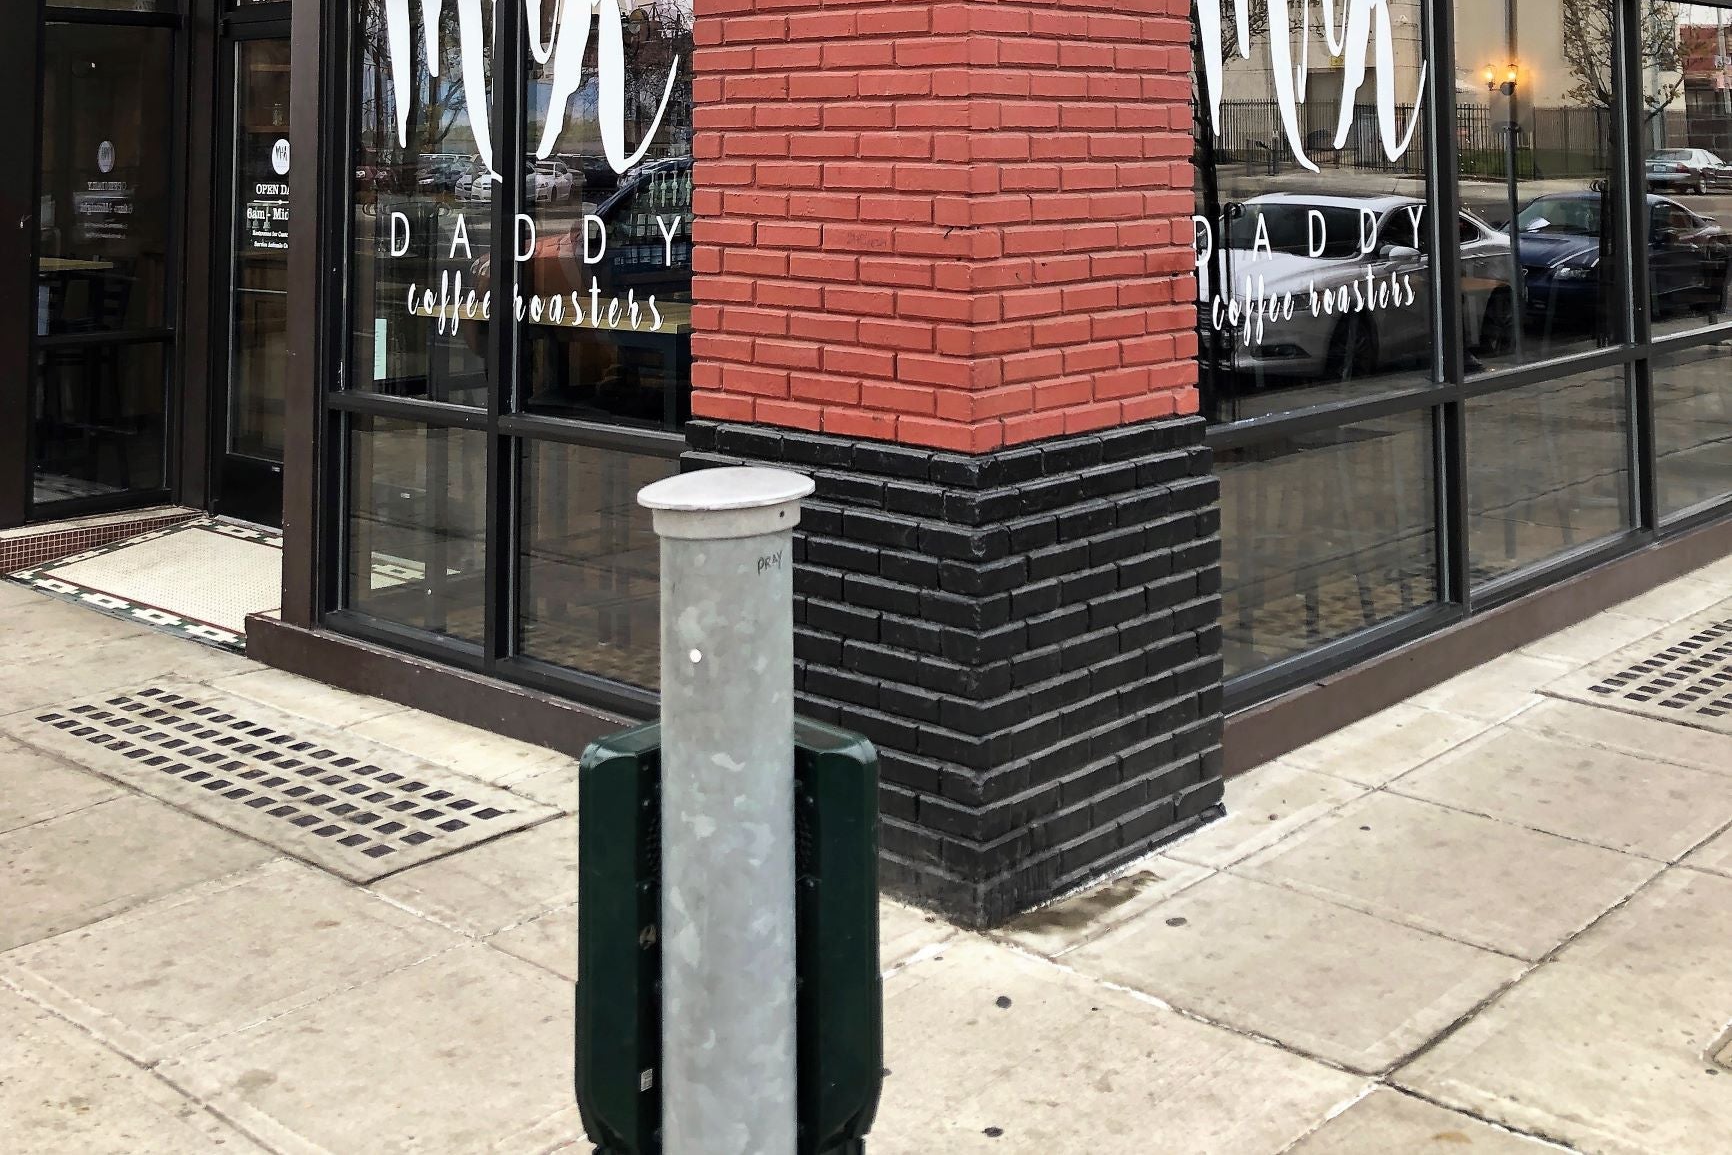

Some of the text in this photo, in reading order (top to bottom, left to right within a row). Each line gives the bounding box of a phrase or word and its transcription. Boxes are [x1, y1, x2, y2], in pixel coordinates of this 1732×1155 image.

[256, 184, 279, 195] OPEN
[390, 211, 682, 267] DADDY
[1192, 204, 1424, 266] DADDY
[407, 269, 664, 337] coffee roasters
[1212, 263, 1416, 347] coffee roasters
